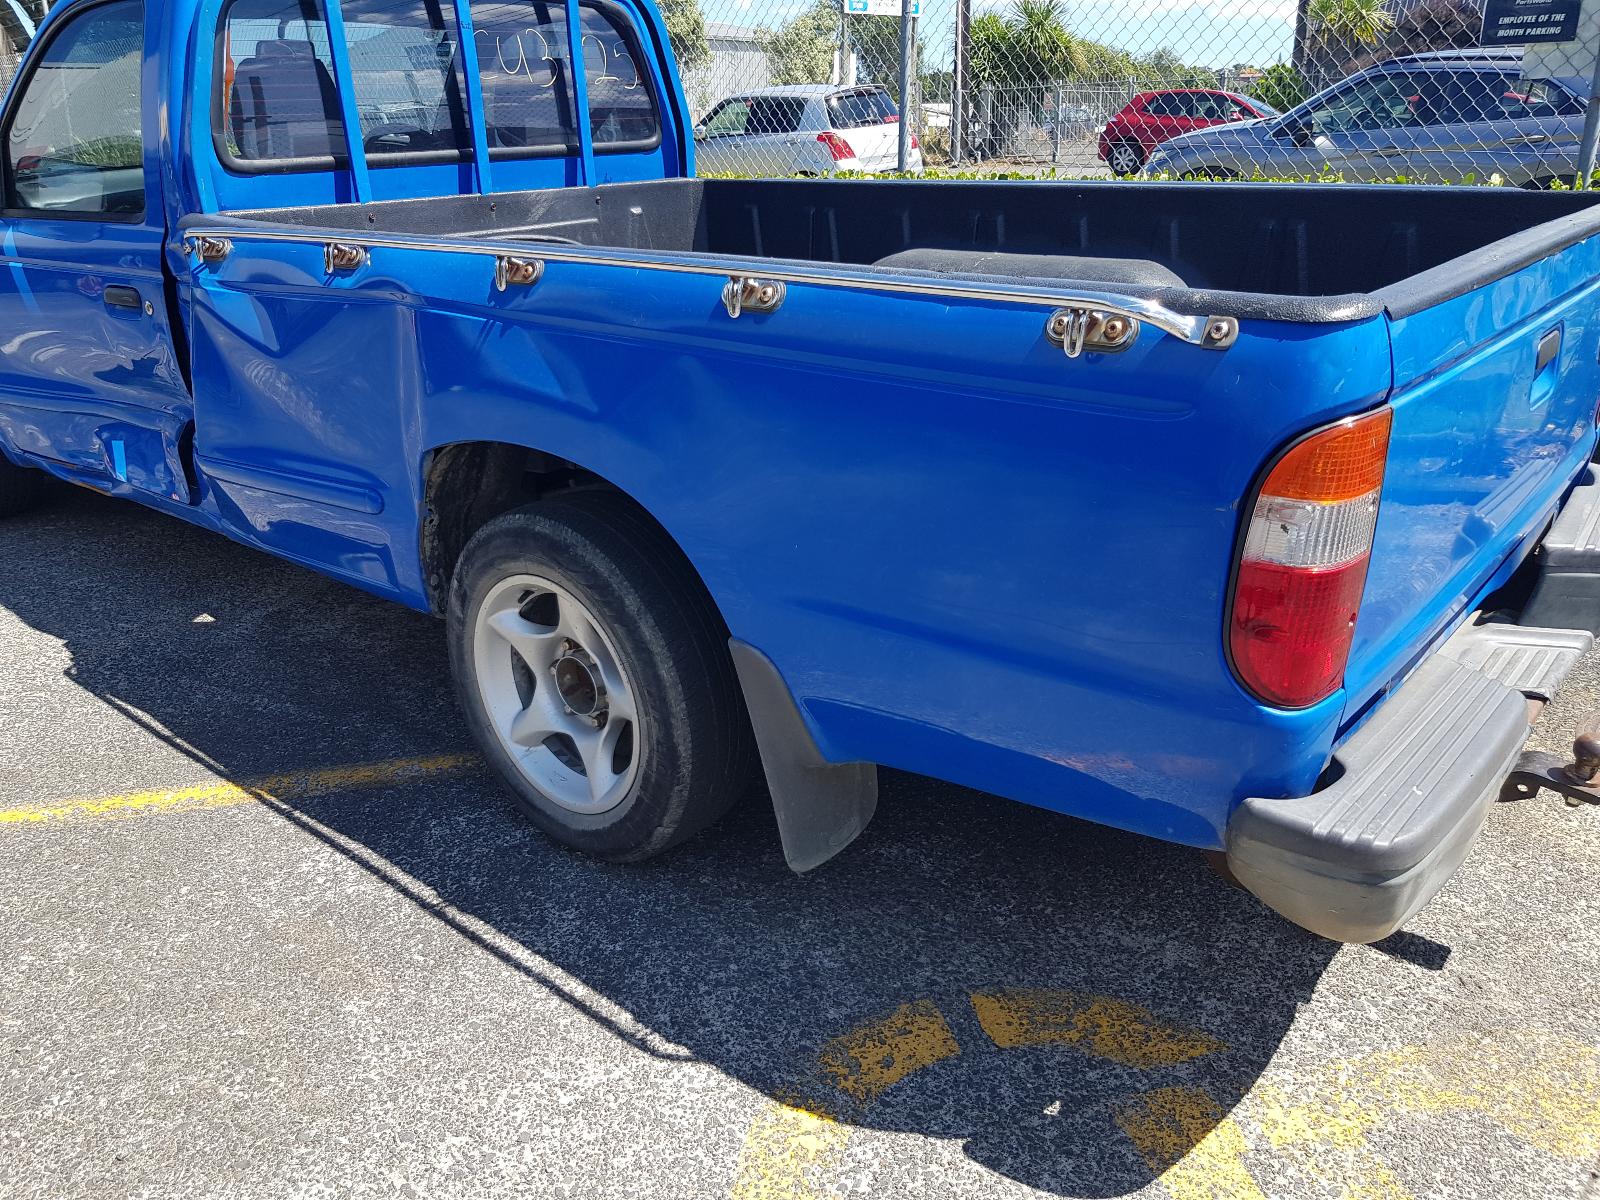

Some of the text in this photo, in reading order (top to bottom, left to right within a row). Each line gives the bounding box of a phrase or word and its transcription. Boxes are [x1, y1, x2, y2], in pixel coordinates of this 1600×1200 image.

[1498, 13, 1566, 25] EMPLOYEE OF THE
[1497, 26, 1562, 37] MONTH PARKING
